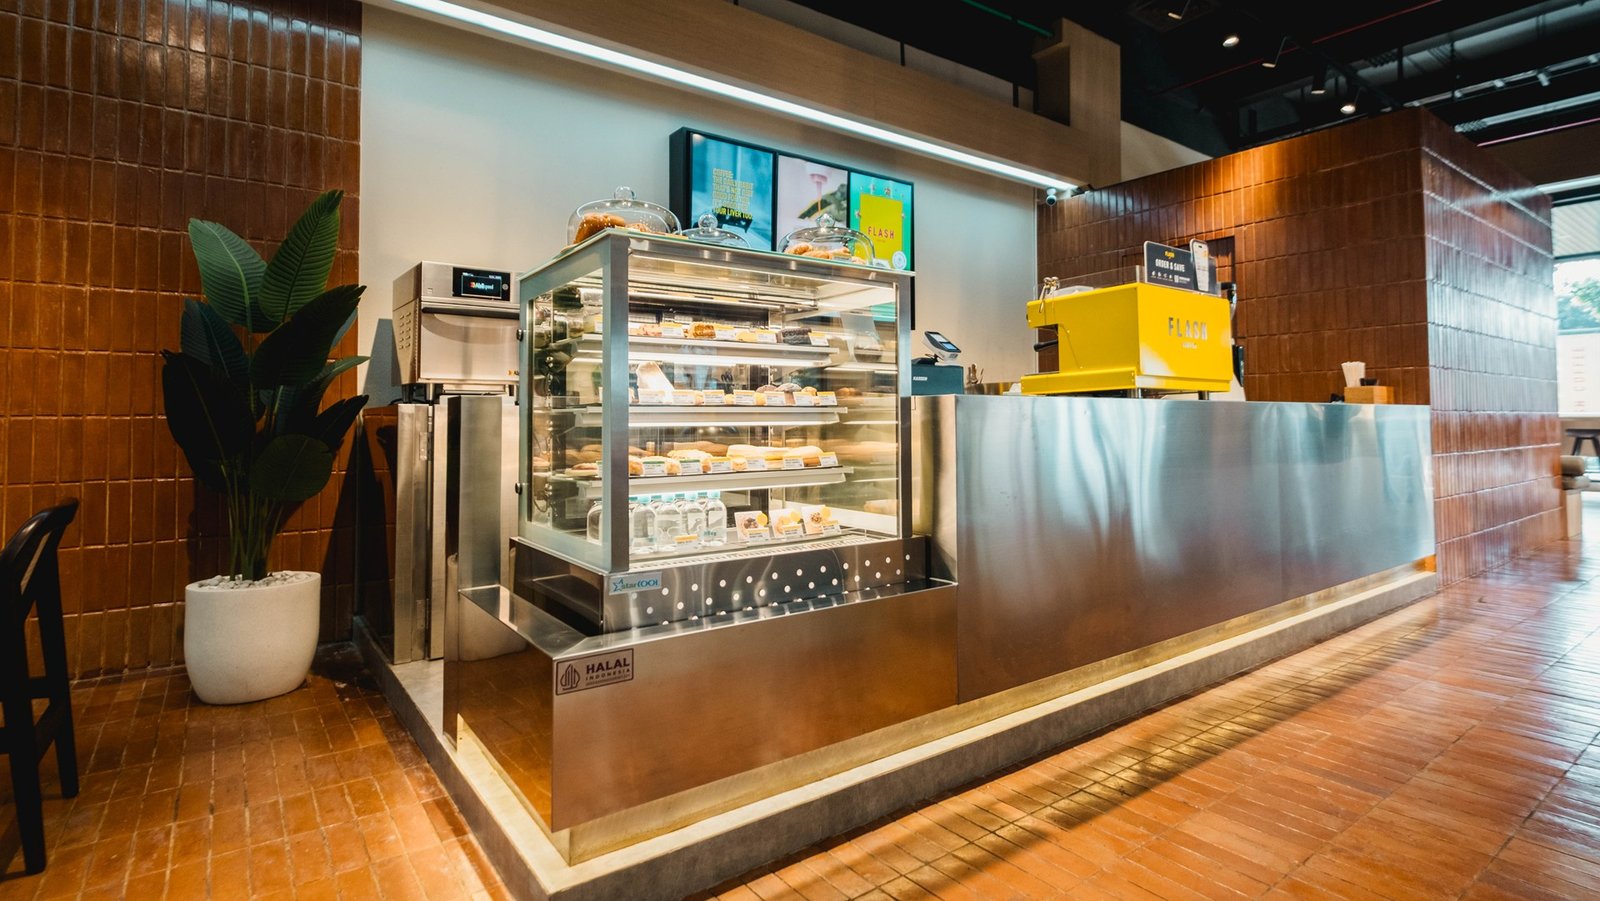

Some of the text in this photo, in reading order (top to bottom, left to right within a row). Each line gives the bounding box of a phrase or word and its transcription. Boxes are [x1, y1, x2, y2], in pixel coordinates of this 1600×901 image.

[728, 208, 741, 217] LIVER
[868, 226, 895, 239] FLASH
[1155, 259, 1170, 269] ORDER
[1174, 263, 1185, 272] SAVE
[1168, 316, 1207, 341] FLASH
[586, 657, 630, 674] HALAL
[586, 668, 630, 680] INDONESIA
